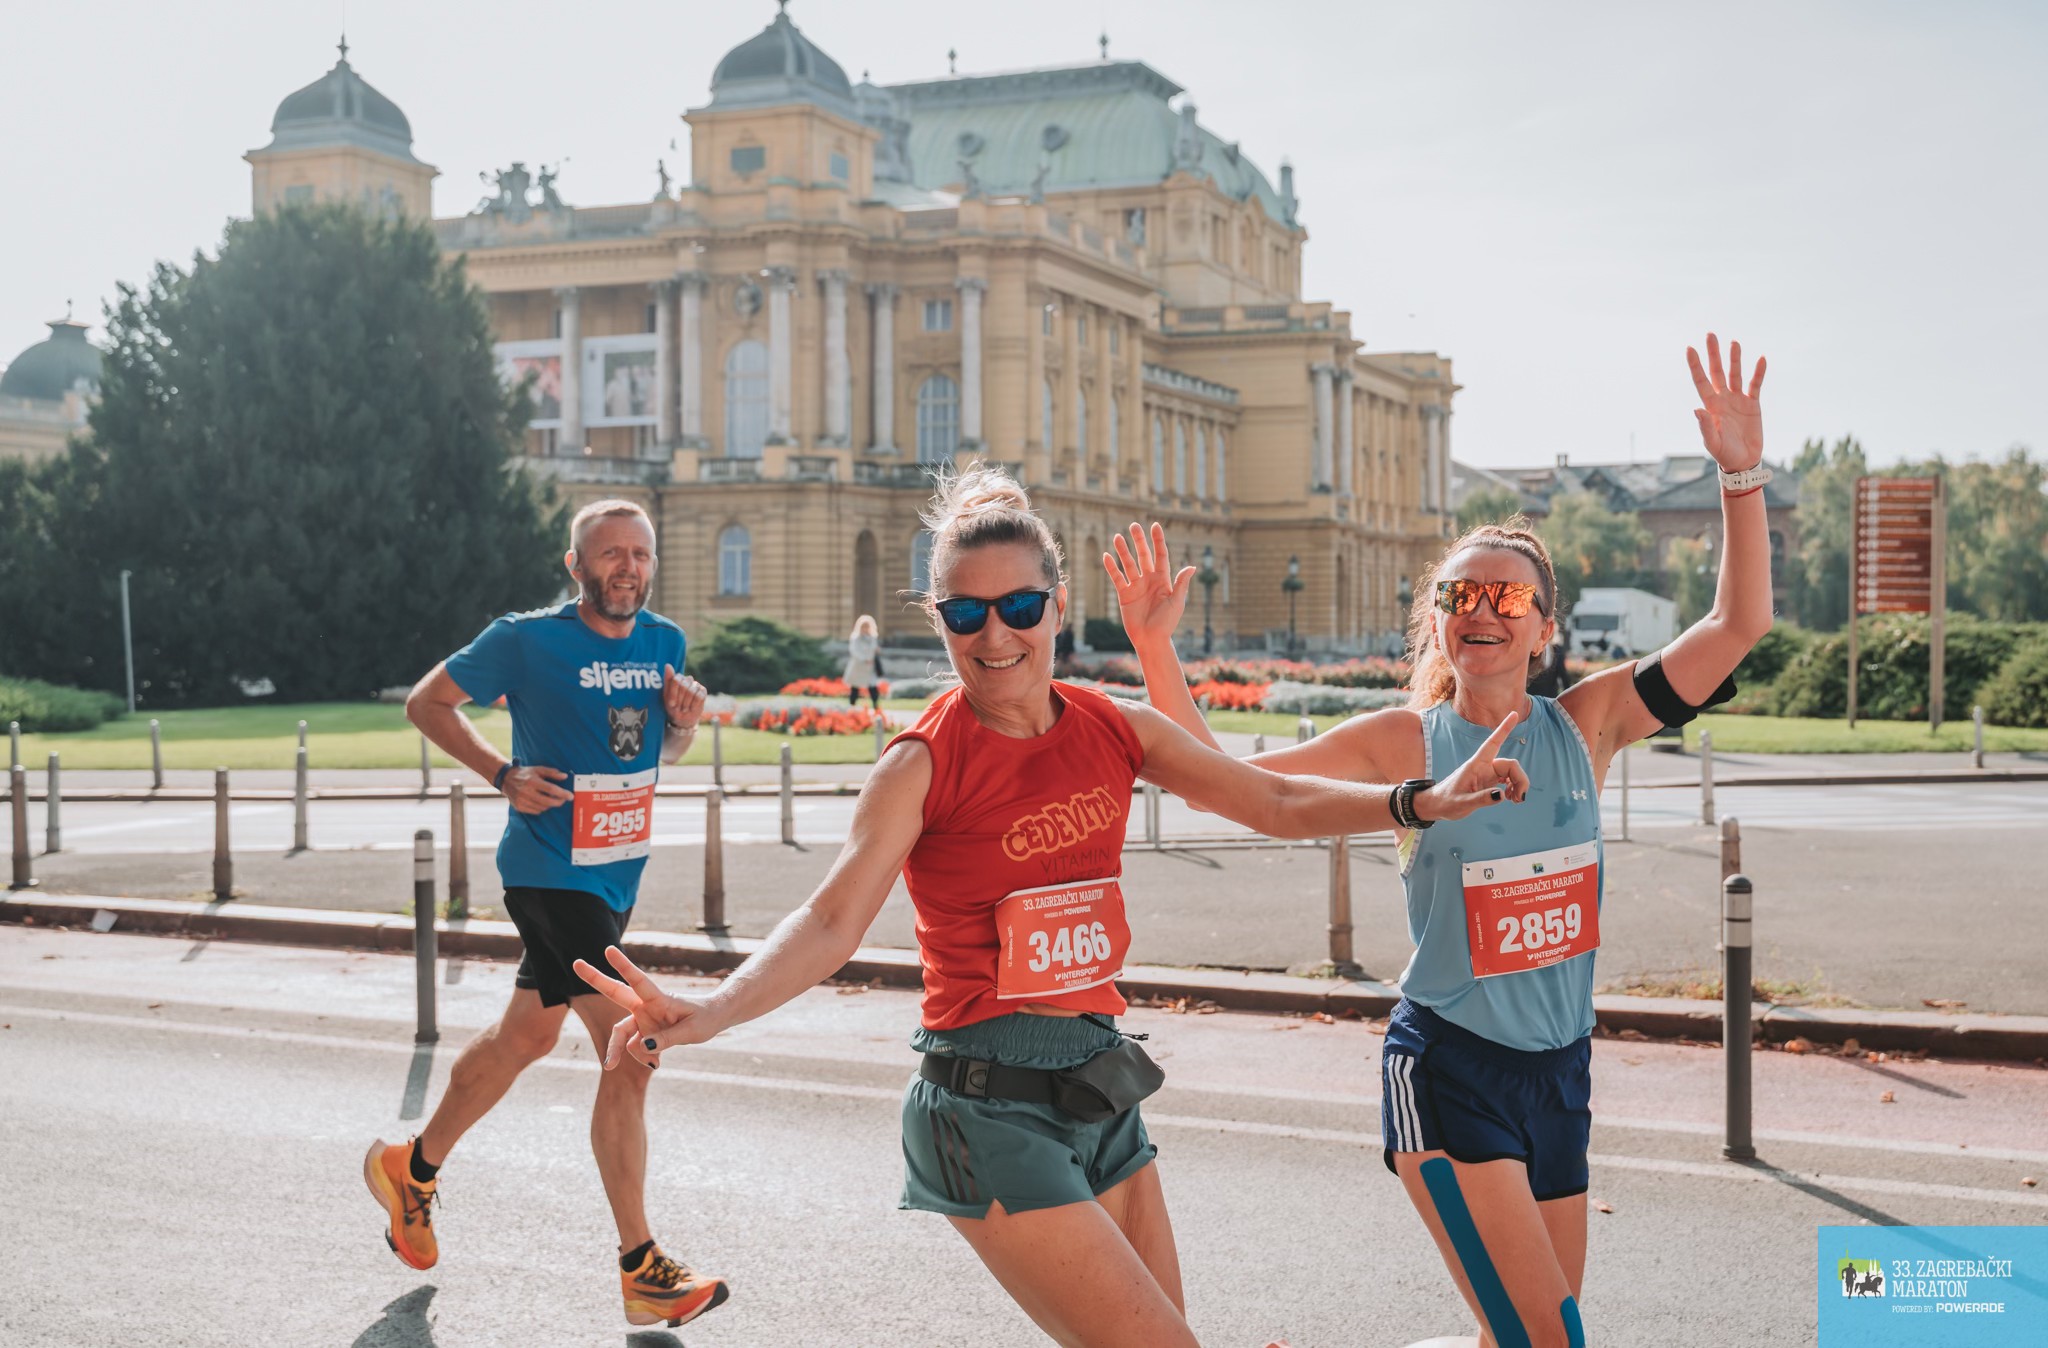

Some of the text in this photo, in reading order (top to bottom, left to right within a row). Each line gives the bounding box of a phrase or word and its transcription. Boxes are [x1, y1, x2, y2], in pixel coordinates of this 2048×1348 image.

[579, 661, 663, 696] sljeme
[591, 807, 646, 837] 2955
[1001, 786, 1121, 862] CEDEVITA
[1040, 846, 1110, 874] VITAMIN
[1491, 872, 1584, 899] 33. ZAGREBAČKI MARATON
[1535, 890, 1567, 902] POWERADE
[1022, 888, 1104, 911] 33. ZAGREBAČKI MARATON
[1064, 905, 1092, 916] POWERADE
[1497, 902, 1582, 954] 2859
[1028, 921, 1111, 973] 3466
[1534, 944, 1571, 960] INTERSPORT
[1062, 966, 1100, 980] INTERSPORT
